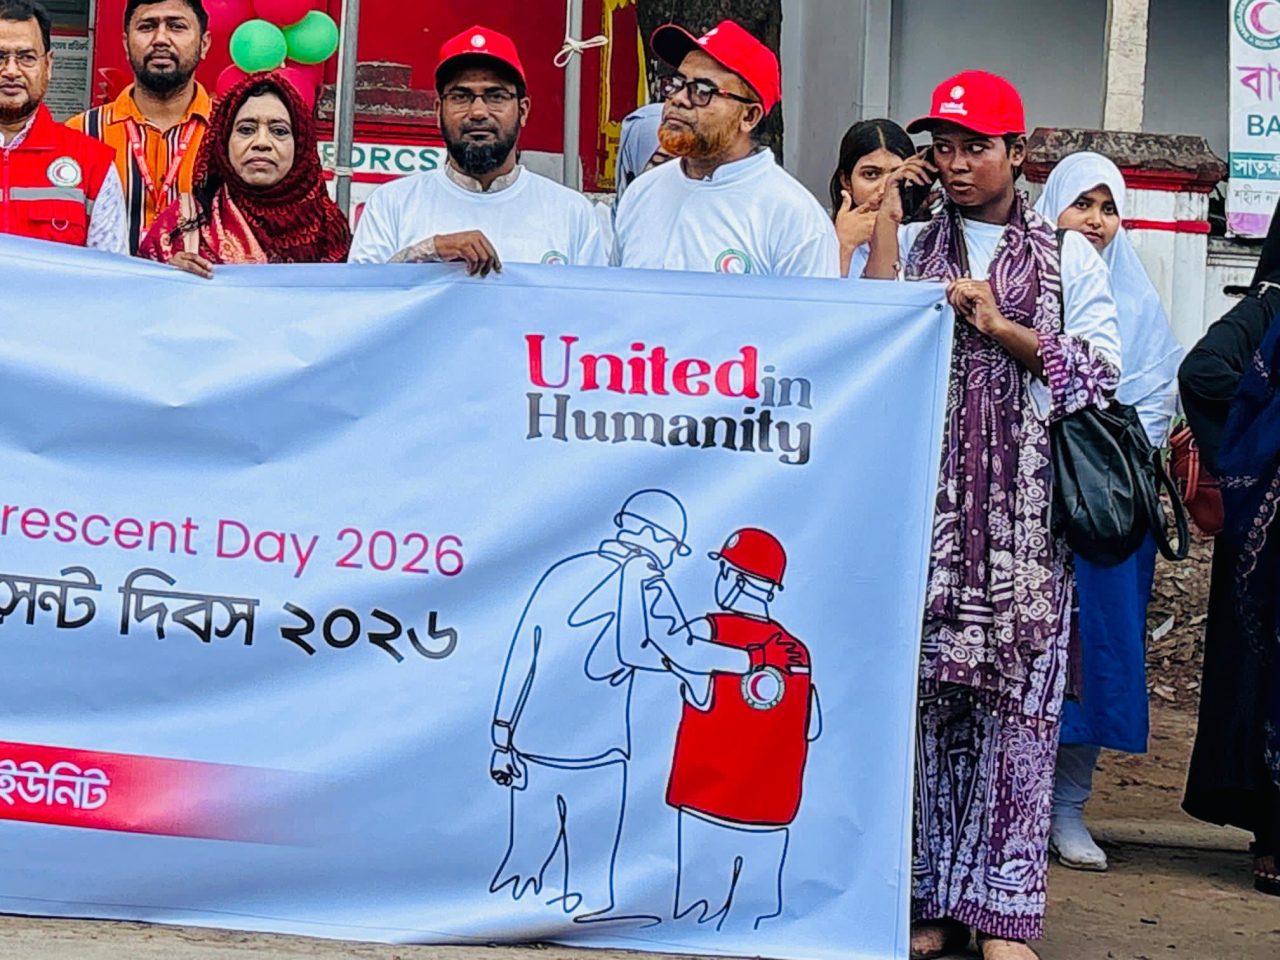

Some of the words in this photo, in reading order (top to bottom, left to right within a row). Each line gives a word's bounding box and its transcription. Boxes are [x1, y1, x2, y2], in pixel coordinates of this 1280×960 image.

[524, 334, 760, 399] United
[761, 365, 813, 410] in
[526, 392, 812, 465] Humanity
[216, 519, 319, 579] Day
[336, 528, 465, 577] 2026
[118, 567, 260, 646] দিবস
[280, 600, 458, 663] ২০২৬
